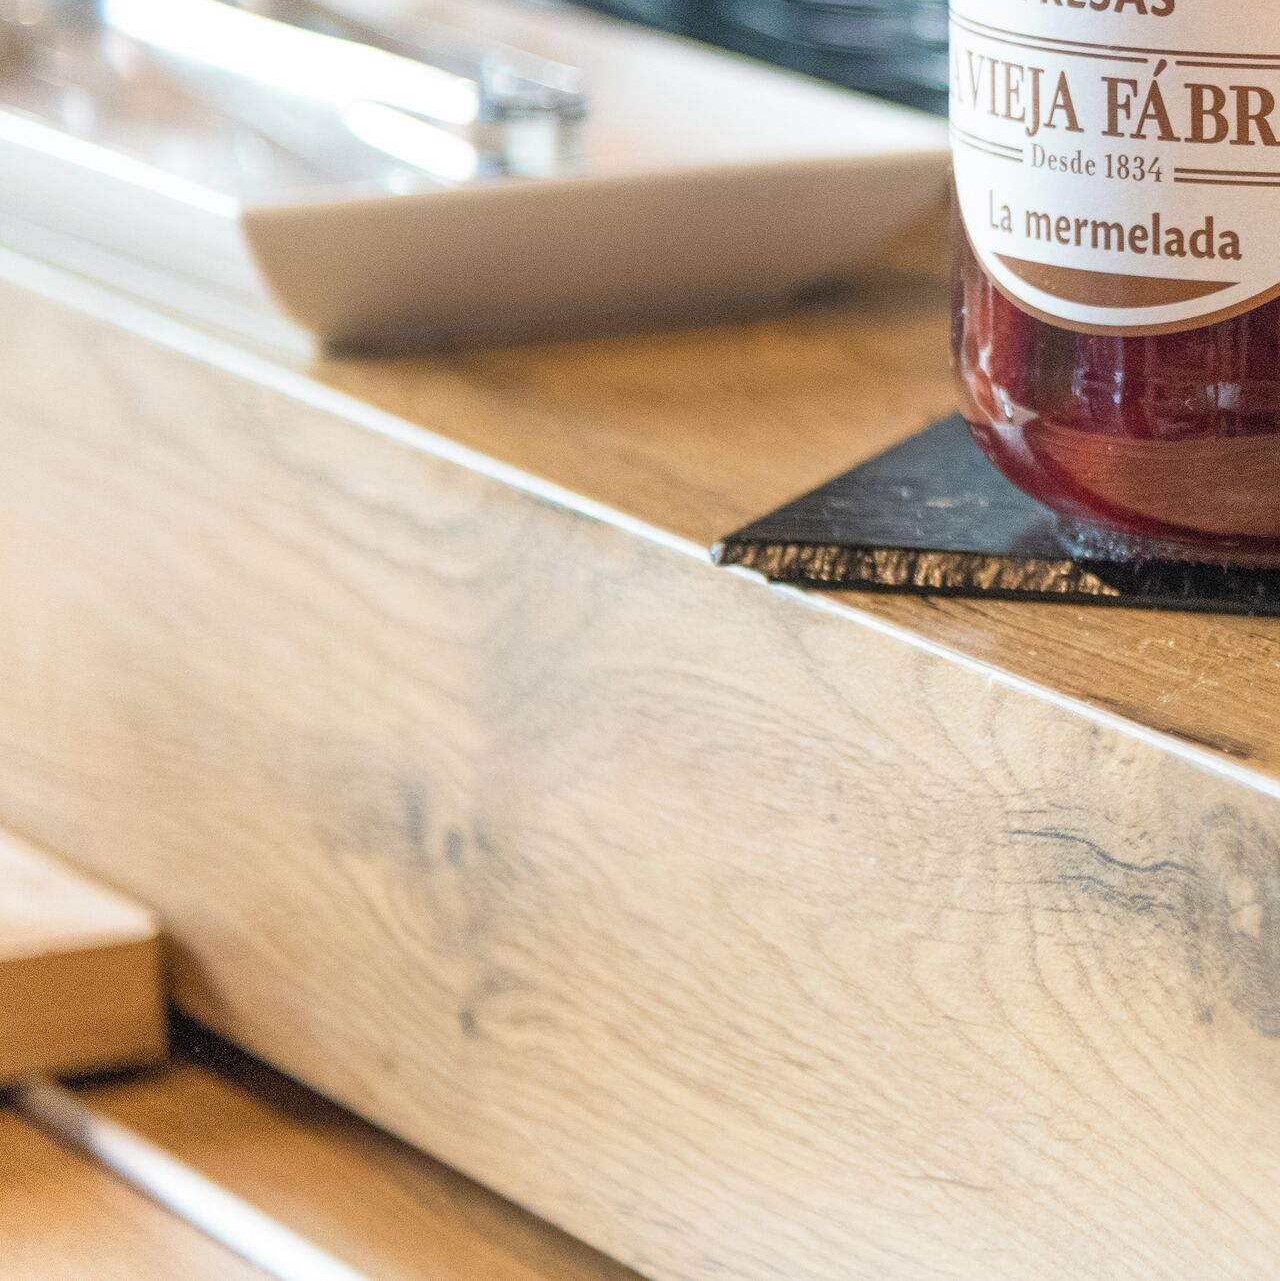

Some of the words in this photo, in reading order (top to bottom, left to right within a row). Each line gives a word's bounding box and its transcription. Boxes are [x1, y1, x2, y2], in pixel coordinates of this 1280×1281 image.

[966, 48, 1085, 138] VIEJA
[1031, 143, 1096, 176] Desde
[1104, 152, 1164, 183] 1834
[988, 190, 1013, 233] La
[1025, 210, 1243, 261] mermelada
